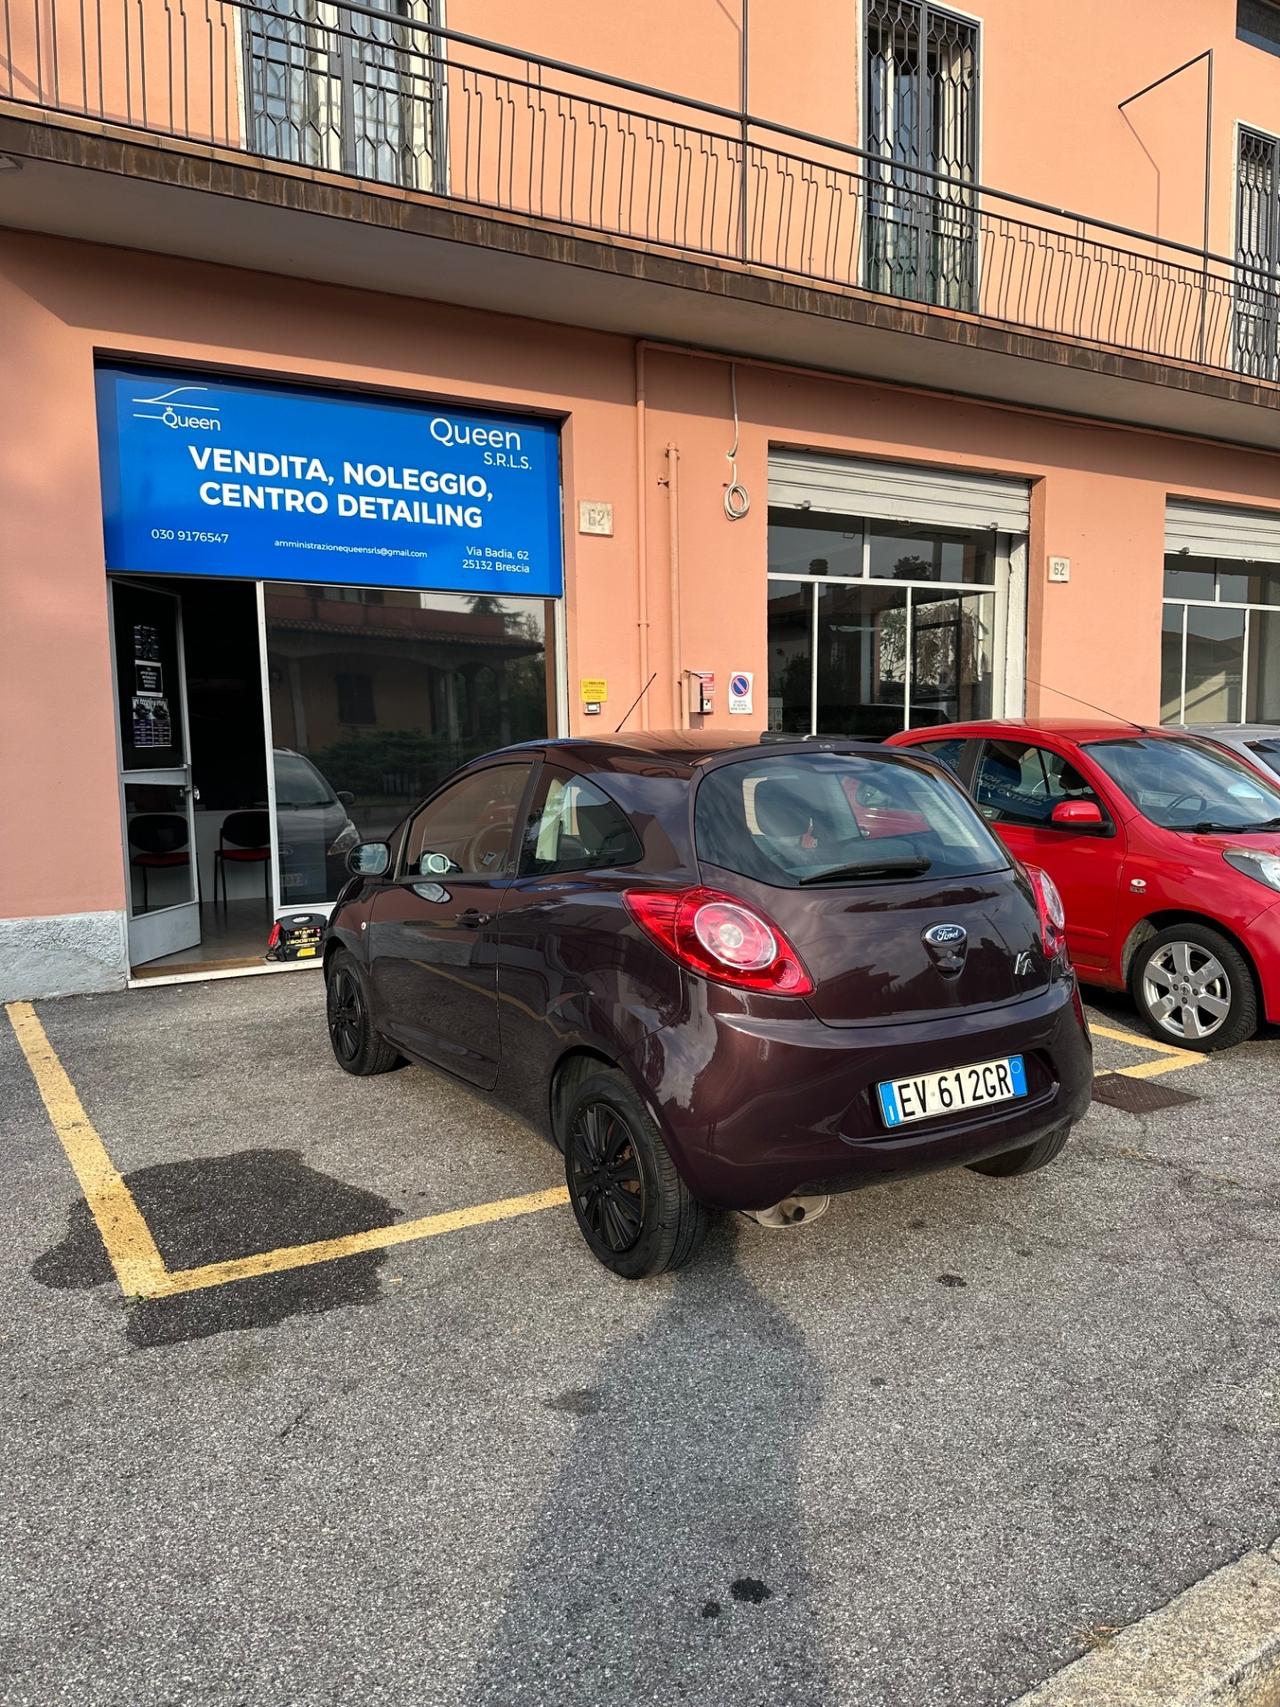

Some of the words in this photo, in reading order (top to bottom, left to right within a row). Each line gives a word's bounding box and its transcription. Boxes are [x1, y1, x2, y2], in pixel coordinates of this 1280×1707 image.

[162, 411, 221, 431] Queen
[429, 417, 521, 450] Queen
[483, 451, 533, 471] S.R.L.S.
[187, 445, 335, 486] VENDITA,
[343, 461, 494, 502] NOLEGGIO,
[199, 481, 329, 515] CENTRO
[337, 493, 483, 529] DETAILING
[151, 528, 175, 541] 030
[177, 530, 229, 544] 9176547
[274, 539, 428, 559] amministrazionequeensrls@gmail.com
[466, 545, 482, 557] Via
[484, 547, 516, 560] Badia,
[516, 550, 530, 561] 62
[462, 559, 493, 571] 25132
[495, 562, 530, 574] Brescia
[1053, 562, 1066, 576] 62
[936, 927, 960, 941] Ford
[897, 1079, 927, 1118] EV
[937, 1064, 1012, 1109] 612GR
